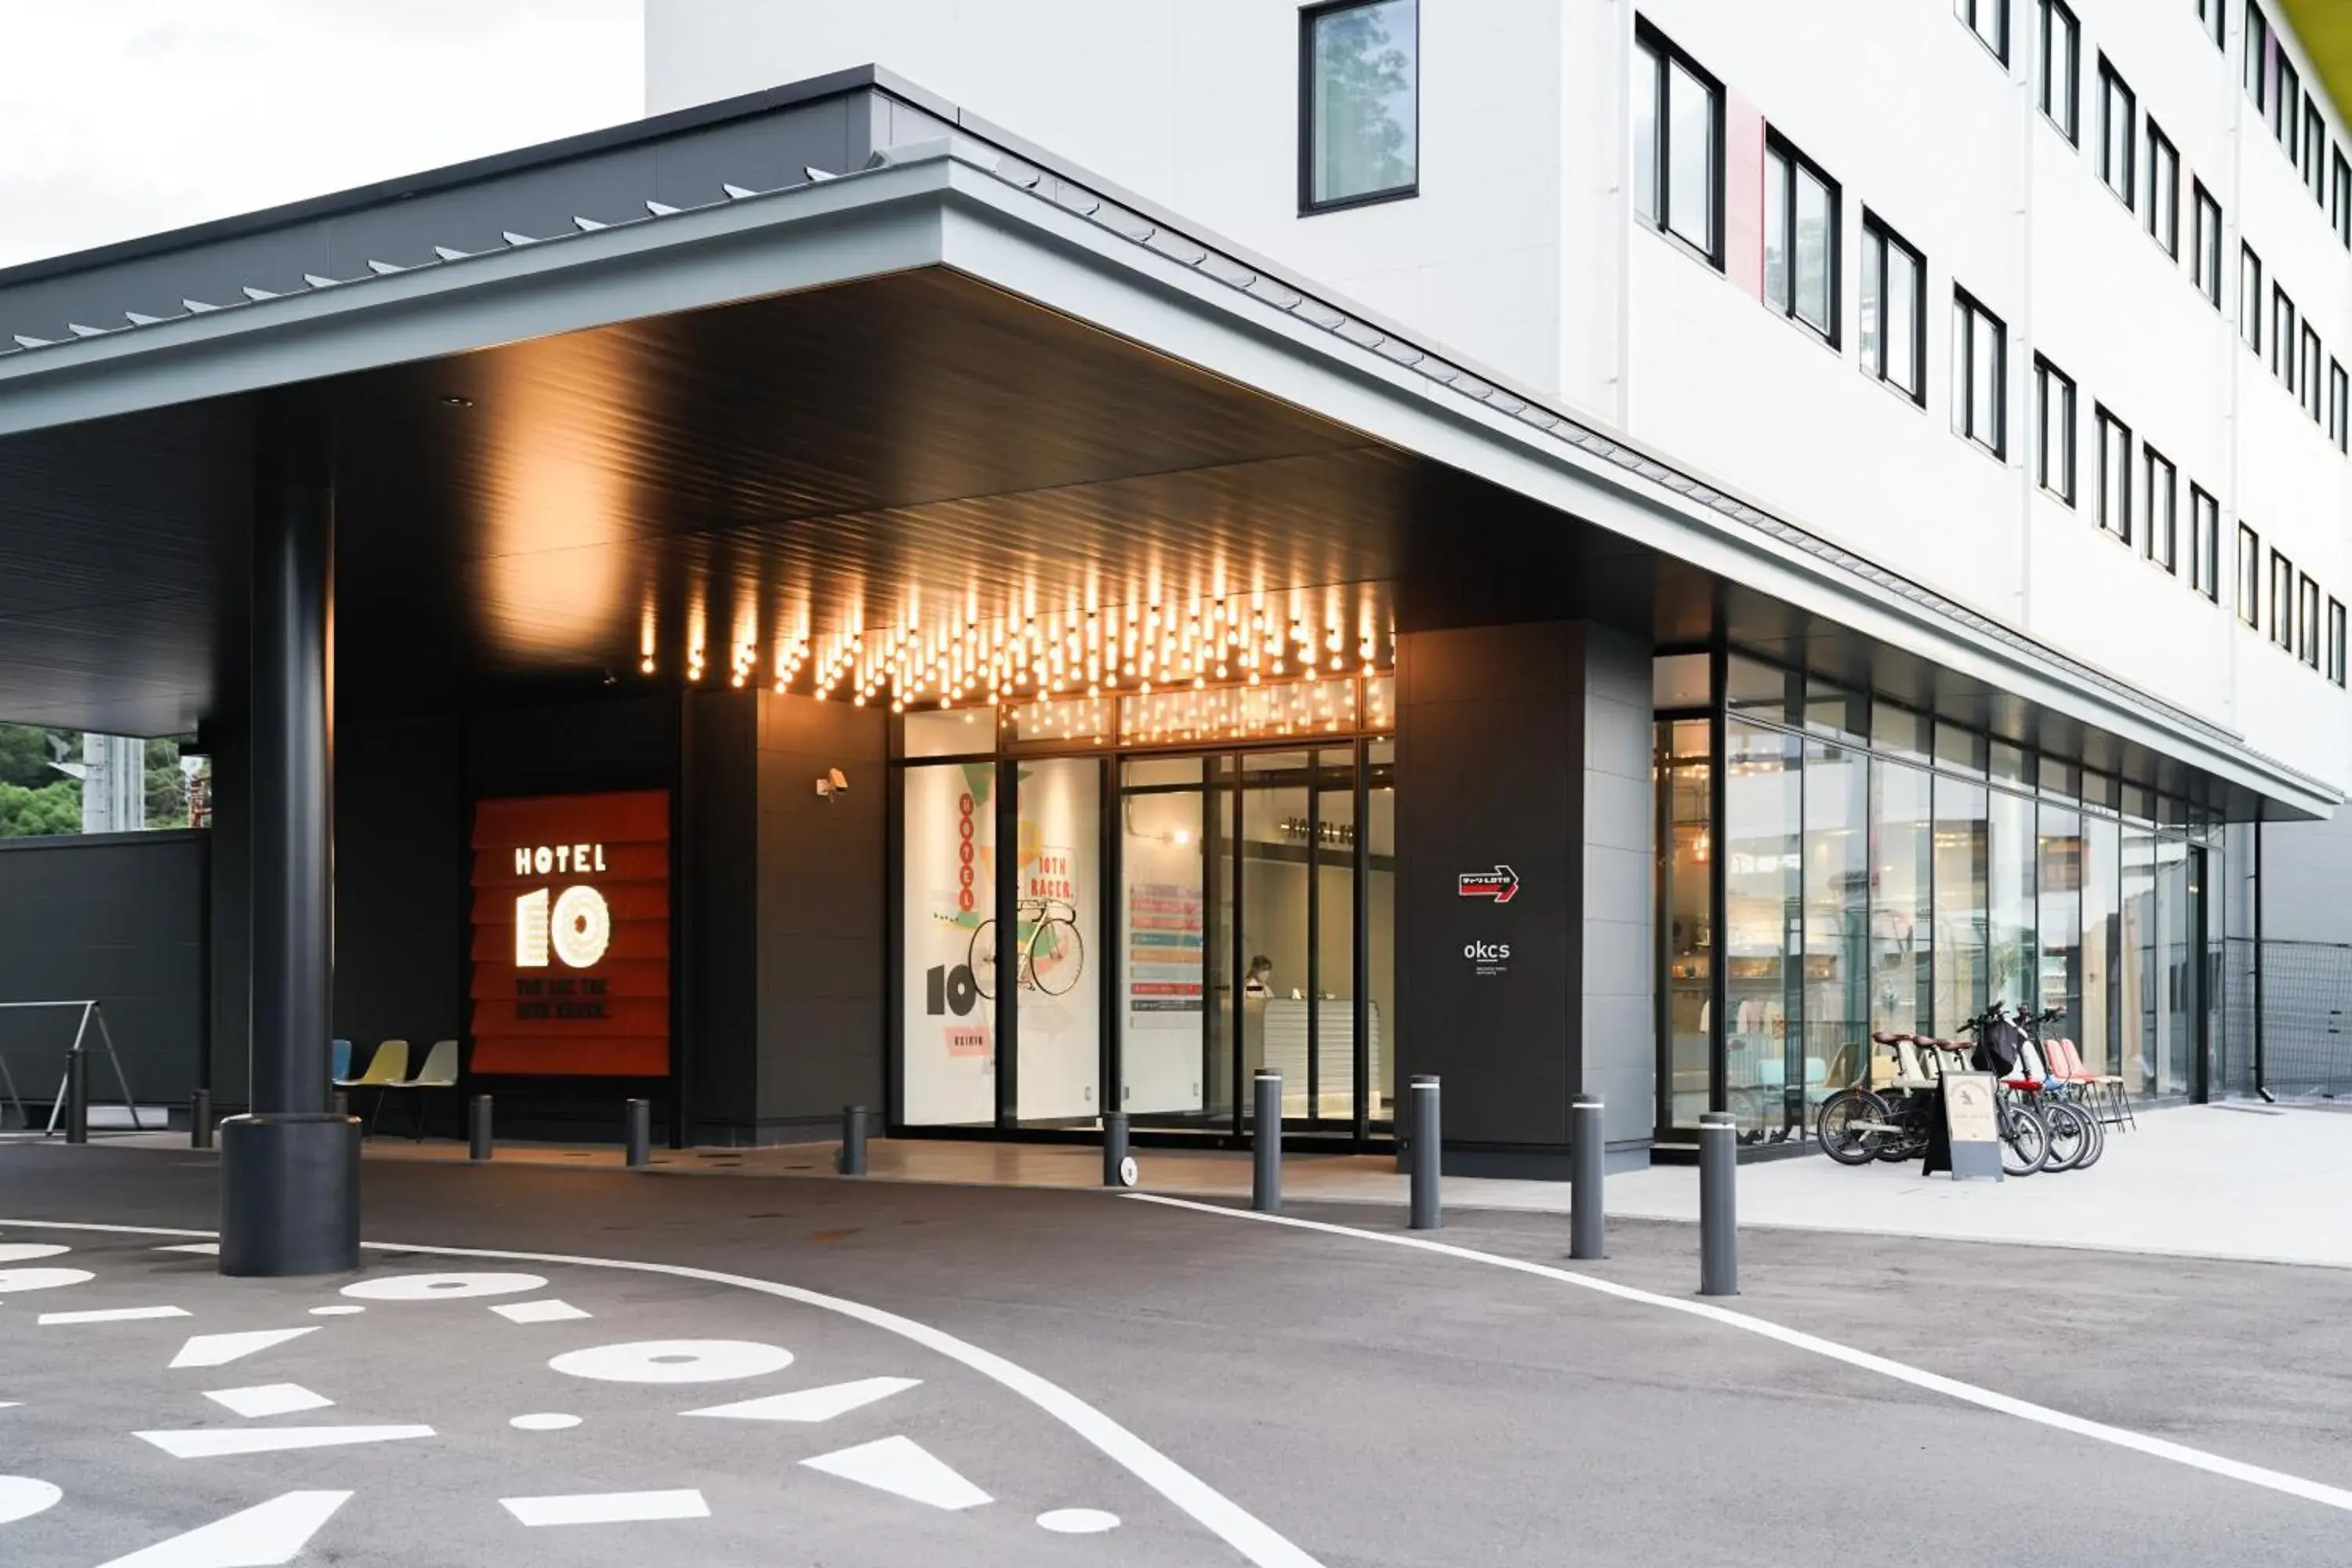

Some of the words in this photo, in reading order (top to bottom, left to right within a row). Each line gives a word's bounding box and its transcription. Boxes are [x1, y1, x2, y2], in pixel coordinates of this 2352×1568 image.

[515, 844, 606, 874] HOTEL
[961, 794, 972, 910] HOTEL
[1039, 856, 1066, 875] 10TH
[515, 885, 610, 968] 10
[1464, 940, 1510, 958] okcs
[927, 964, 977, 1016] 10
